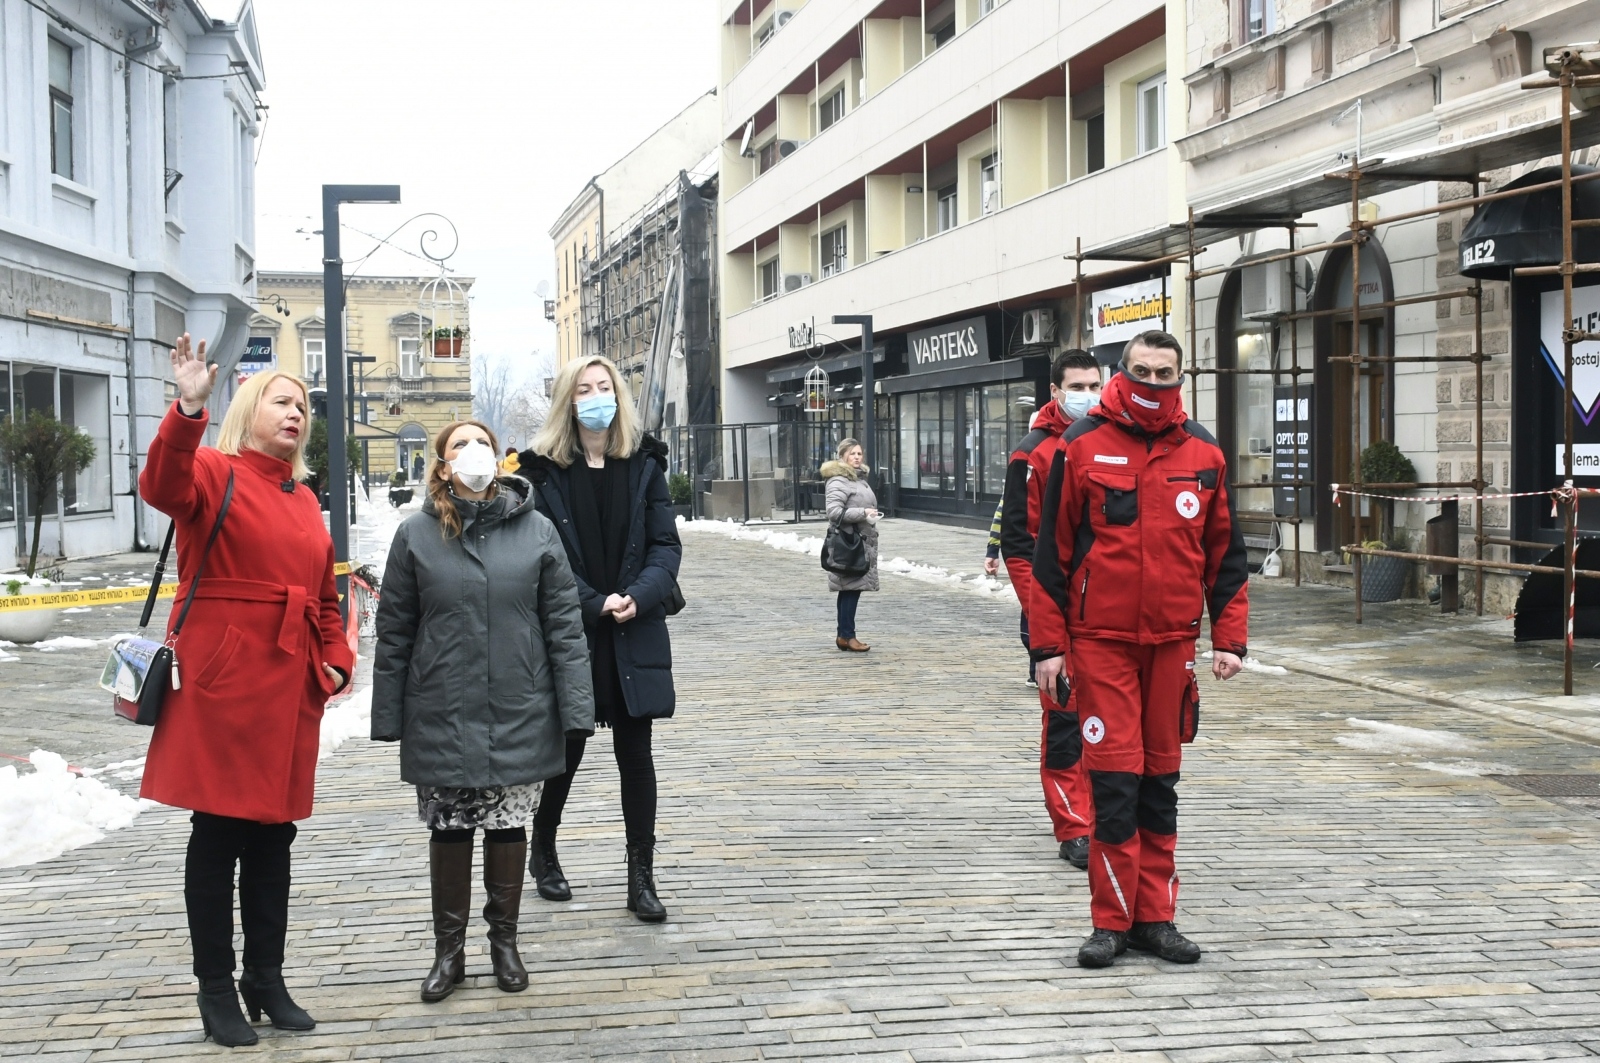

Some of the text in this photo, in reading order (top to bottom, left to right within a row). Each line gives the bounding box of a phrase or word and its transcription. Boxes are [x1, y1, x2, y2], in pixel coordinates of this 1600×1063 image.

[1463, 239, 1495, 267] TELE2
[1358, 282, 1379, 295] PTIKA
[1103, 298, 1141, 327] Hrvatska
[912, 326, 979, 365] VARTEKS
[1563, 452, 1600, 466] lema
